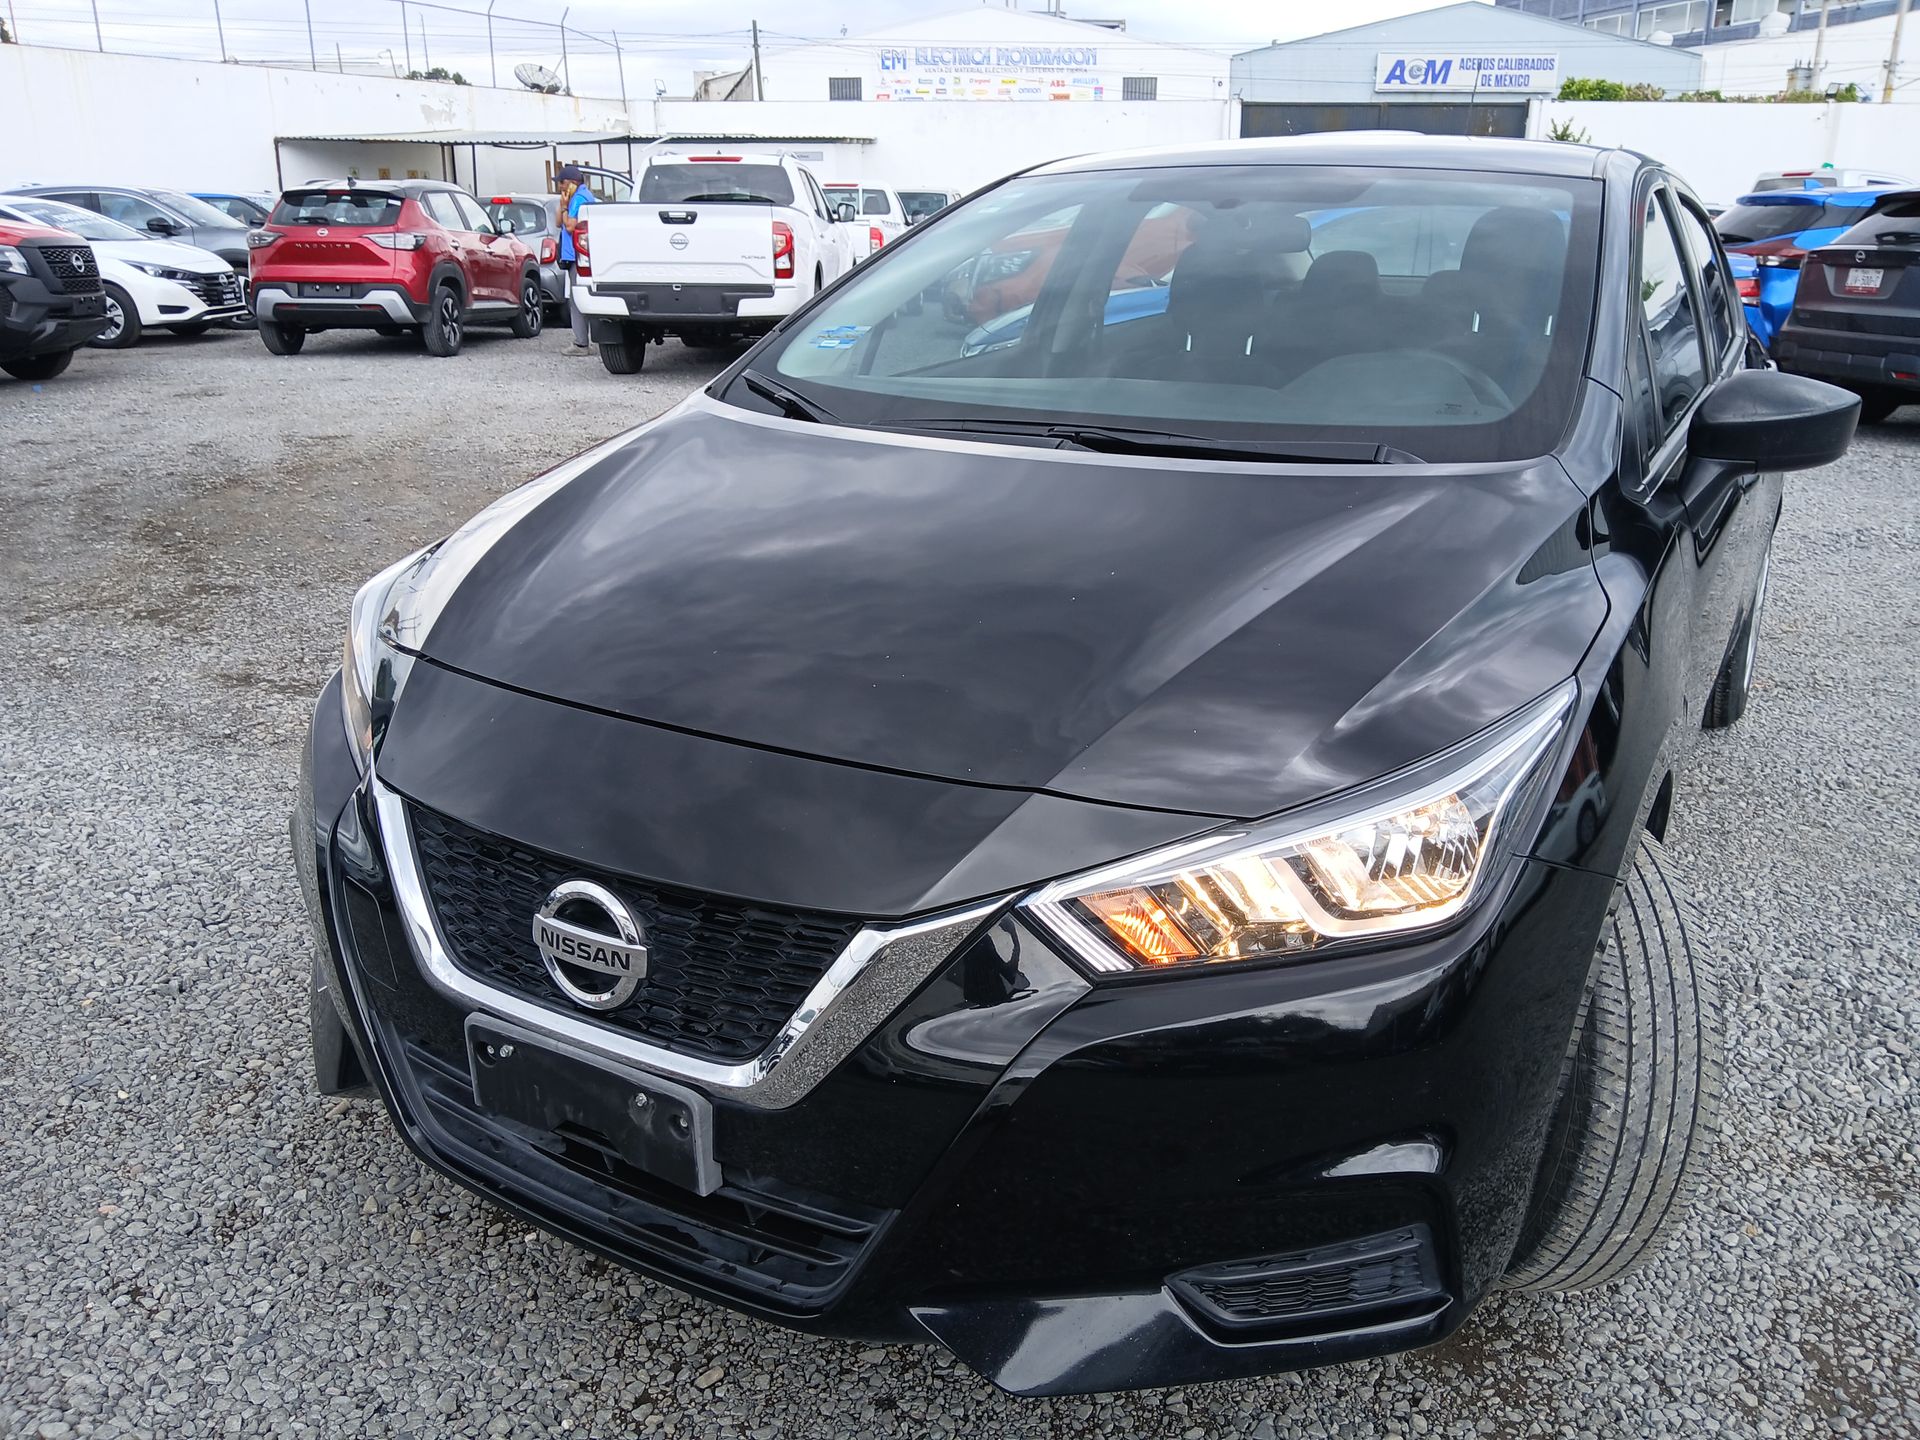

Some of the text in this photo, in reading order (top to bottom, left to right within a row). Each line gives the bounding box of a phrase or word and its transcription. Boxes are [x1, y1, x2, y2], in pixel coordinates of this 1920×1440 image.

[881, 49, 907, 70] EM
[1459, 57, 1556, 71] ACEROS CALIBRADOS
[1481, 74, 1493, 87] DE
[541, 926, 631, 971] NISSAN
